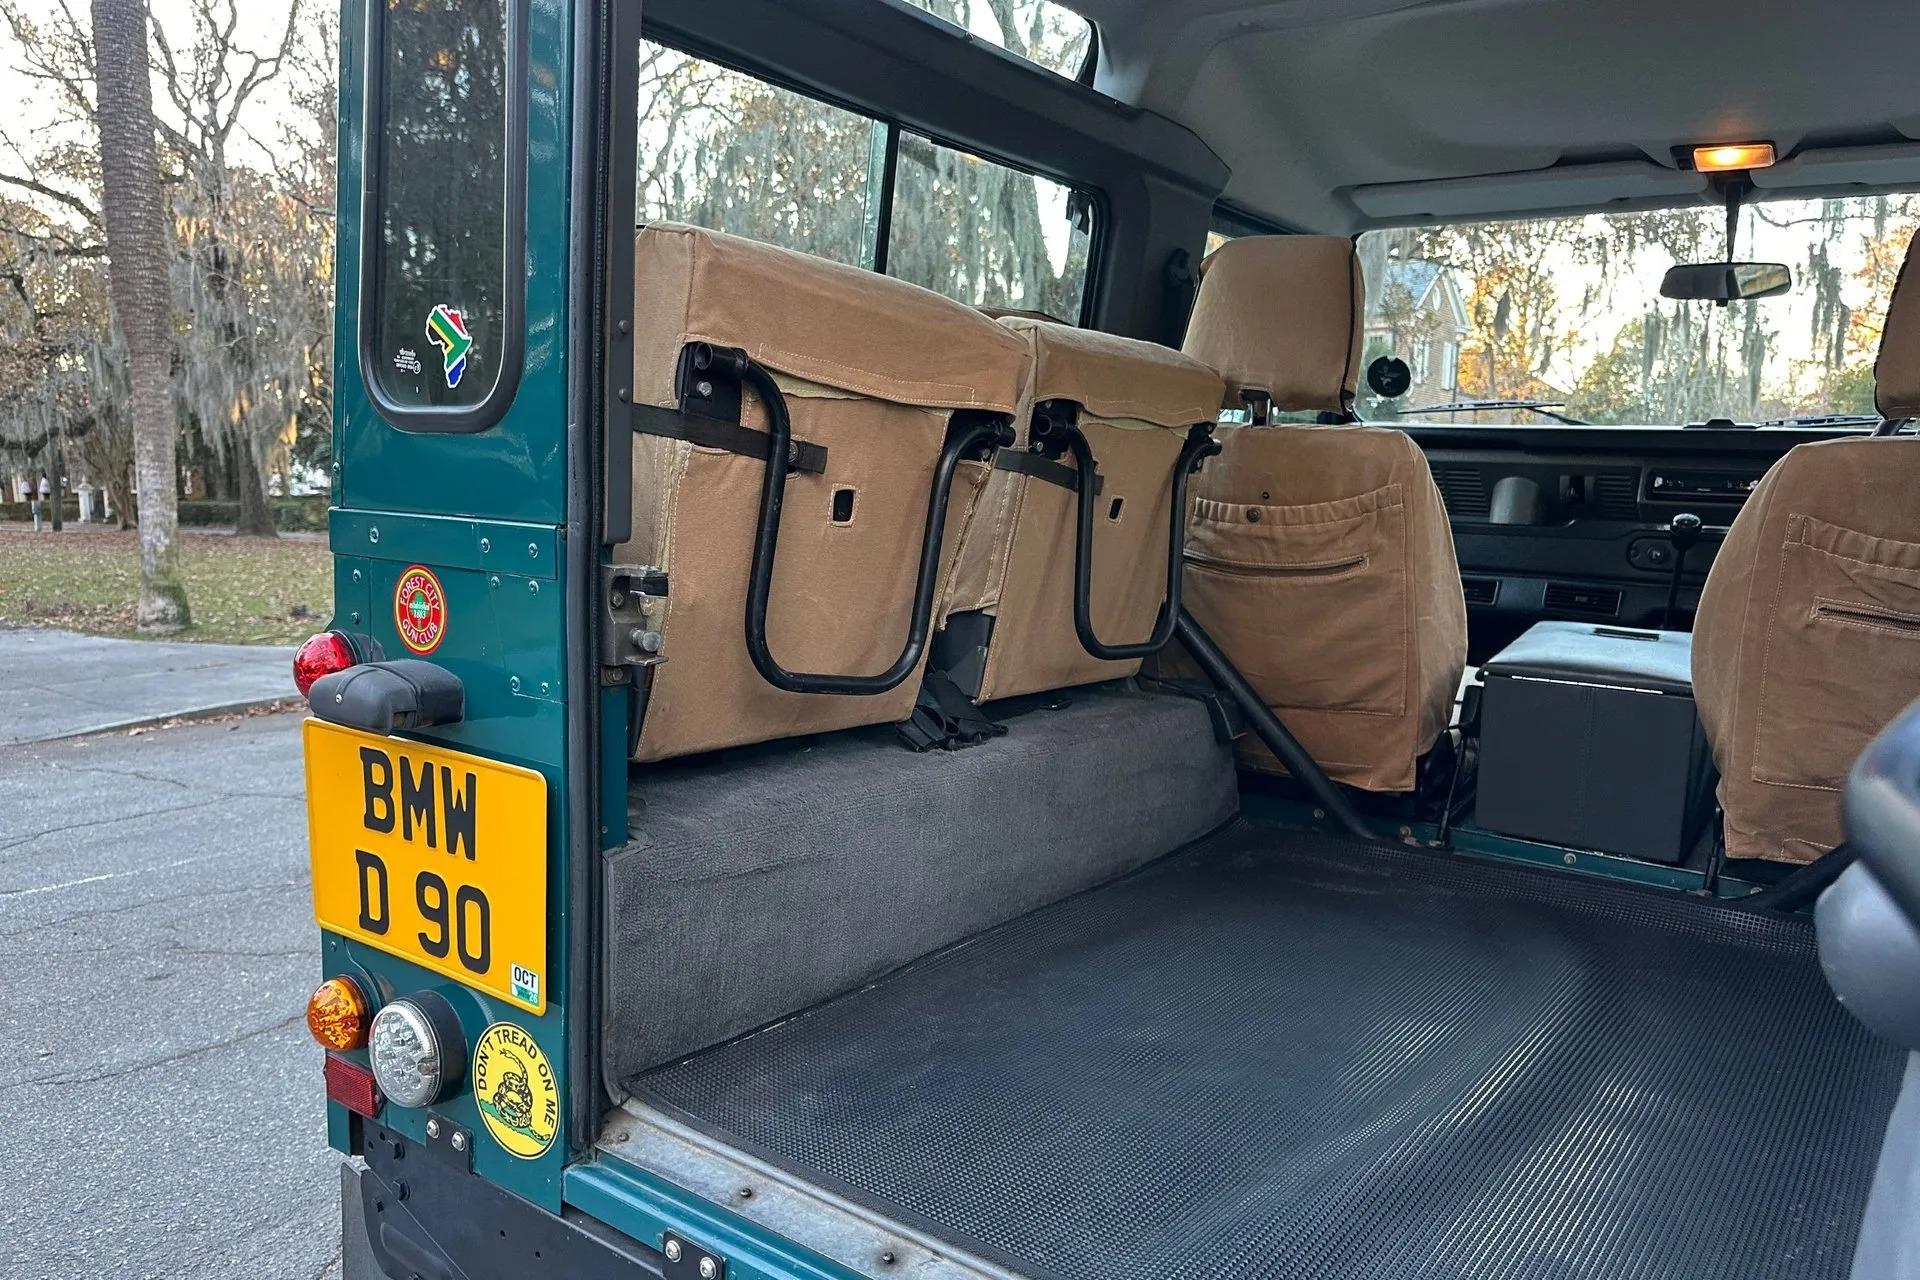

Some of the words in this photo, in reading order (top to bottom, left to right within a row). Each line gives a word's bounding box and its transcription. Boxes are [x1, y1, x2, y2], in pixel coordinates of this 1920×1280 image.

[400, 576, 425, 606] FOREST
[425, 583, 440, 610] CITY
[402, 618, 418, 643] GUN
[419, 622, 438, 644] CLUB
[359, 746, 477, 861] BMW
[355, 849, 390, 936] D
[415, 870, 491, 975] 90
[514, 966, 537, 988] OCT
[494, 1029, 537, 1060] TREAD
[478, 1036, 495, 1091] DON'T
[538, 1063, 554, 1092] ON
[544, 1098, 556, 1129] ME
